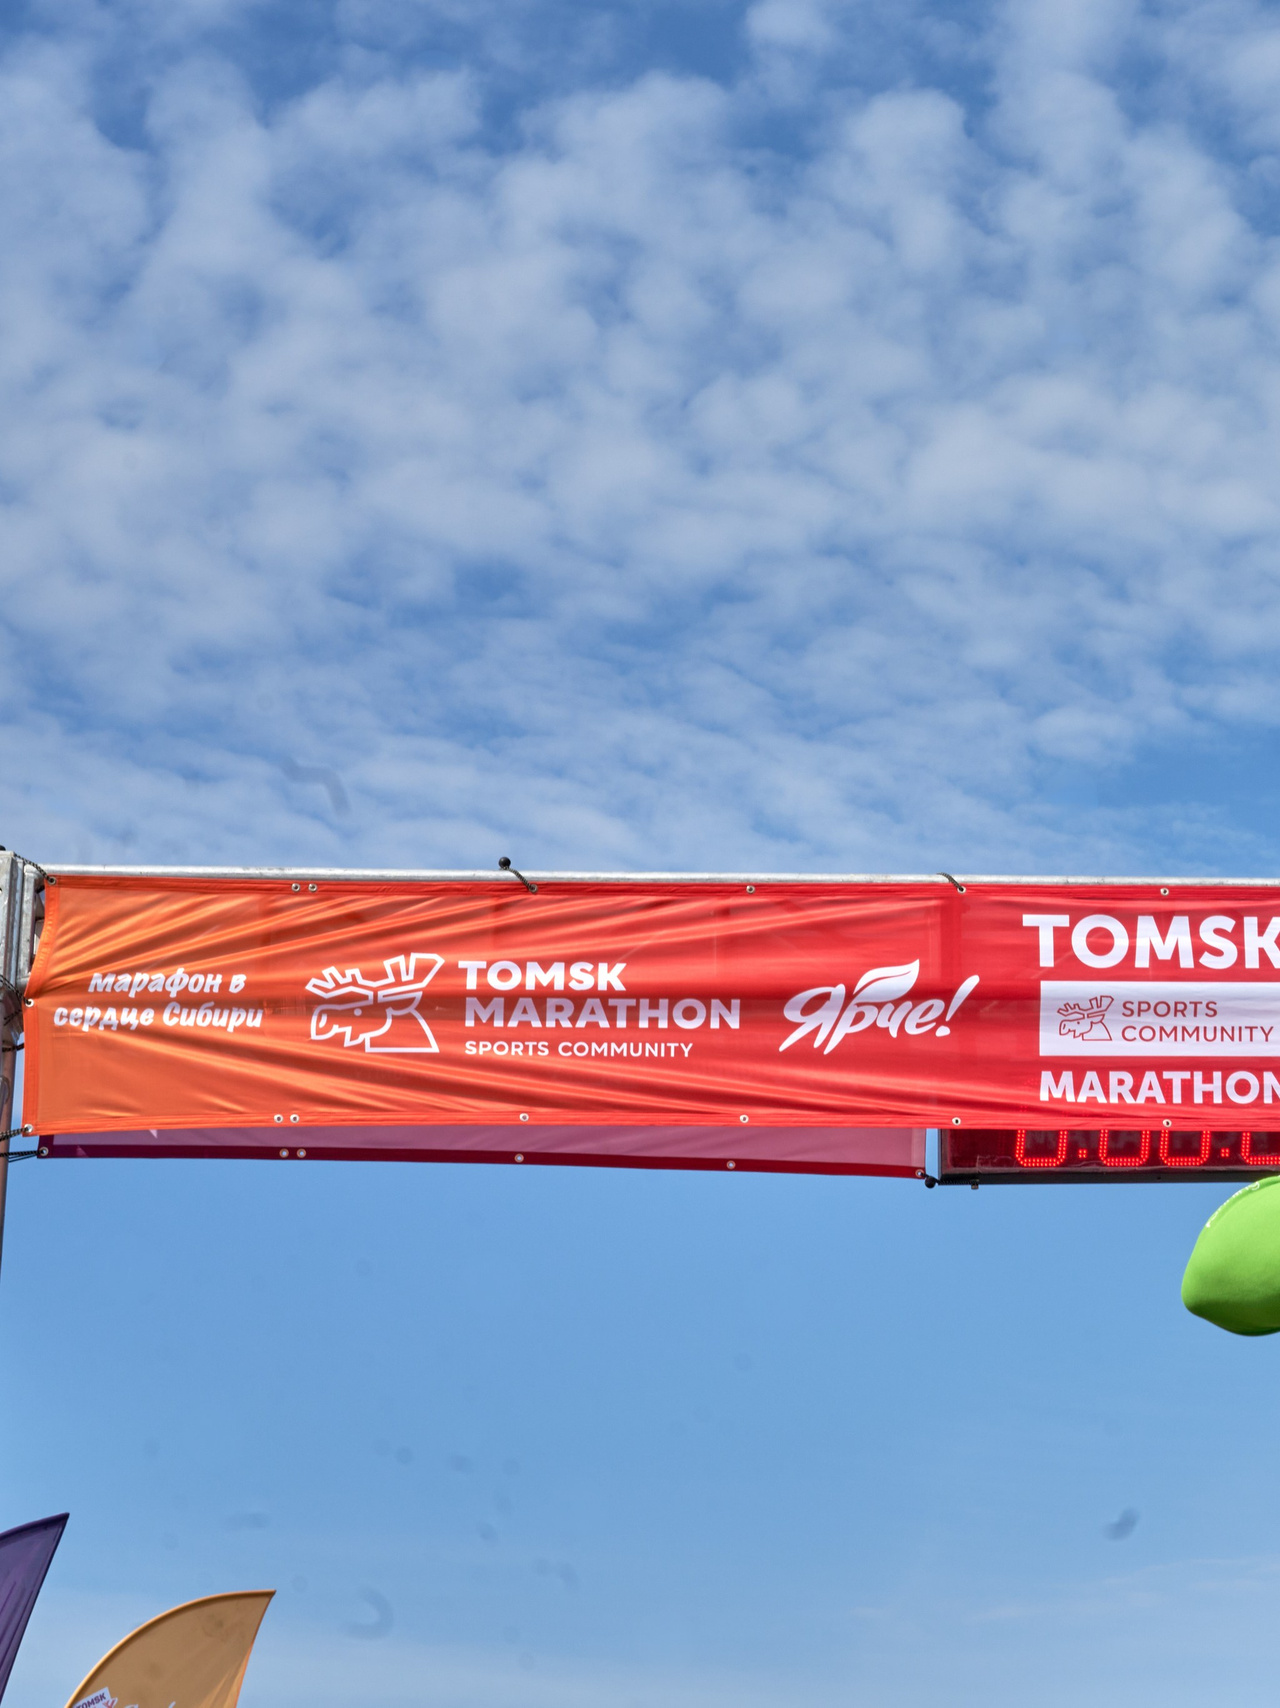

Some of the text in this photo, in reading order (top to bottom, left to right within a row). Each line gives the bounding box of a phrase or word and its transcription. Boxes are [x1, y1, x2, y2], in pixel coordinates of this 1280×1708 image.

[88, 967, 247, 998] марафон в
[457, 960, 627, 990] TOMSK
[53, 1002, 264, 1033] сердце Сибири
[464, 997, 741, 1029] MARATHON
[779, 975, 980, 1055] Ярче!
[1121, 1001, 1218, 1018] SPORTS
[464, 1040, 694, 1058] SPORTS COMMUNITY
[1121, 1025, 1275, 1043] COMMUNITY
